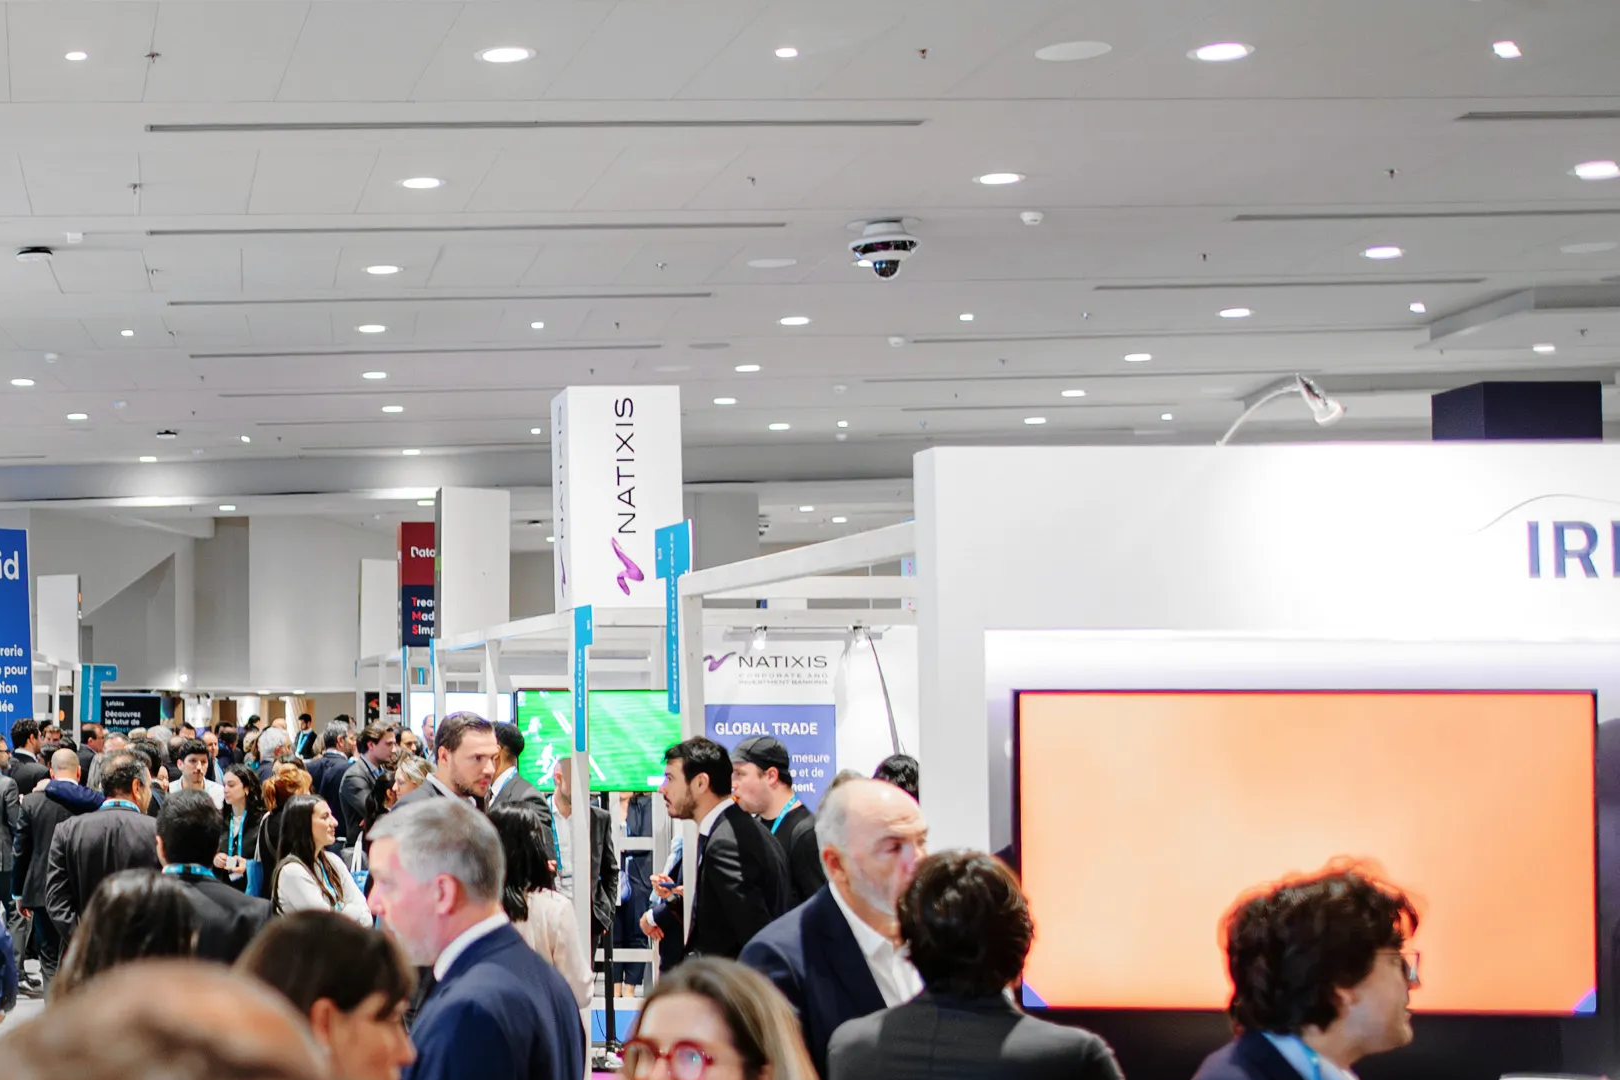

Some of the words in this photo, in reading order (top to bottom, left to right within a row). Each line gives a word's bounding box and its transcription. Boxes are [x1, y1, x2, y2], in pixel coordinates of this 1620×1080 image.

[615, 397, 636, 533] NATIXIS
[1526, 520, 1620, 579] IR
[411, 597, 435, 607] Trea
[738, 655, 828, 669] NATIXIS
[4, 666, 28, 678] pour
[105, 710, 141, 718] Découvrez
[715, 722, 769, 735] GLOBAL
[772, 722, 818, 735] TRADE
[791, 754, 830, 763] mesure
[799, 768, 809, 777] et
[811, 767, 824, 777] de
